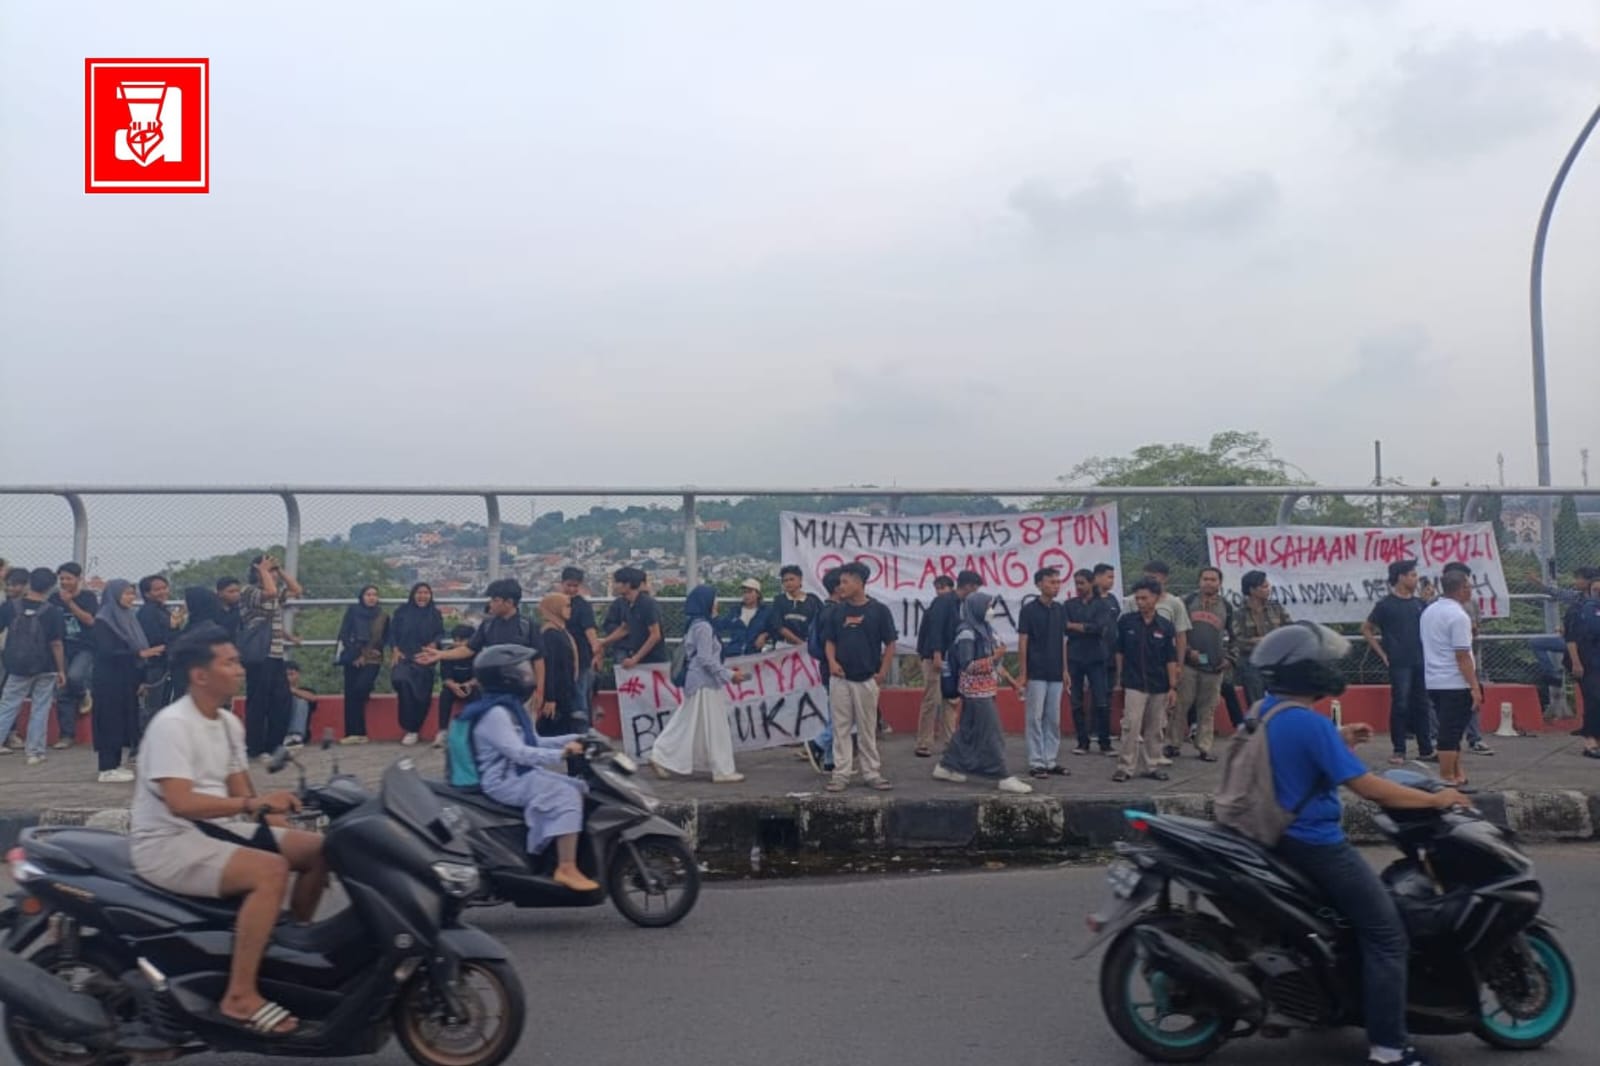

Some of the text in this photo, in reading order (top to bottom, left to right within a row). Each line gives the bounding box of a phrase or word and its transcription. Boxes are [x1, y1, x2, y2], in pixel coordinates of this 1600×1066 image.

[792, 517, 911, 549] MUATAN
[1018, 516, 1046, 546] 8
[1050, 509, 1109, 546] TON
[1212, 527, 1494, 569] PERUSAHAAN TIDAK PEDULI
[853, 551, 1029, 590] DILARANG
[1299, 580, 1359, 606] NYAWA
[631, 691, 827, 757] BUKA
